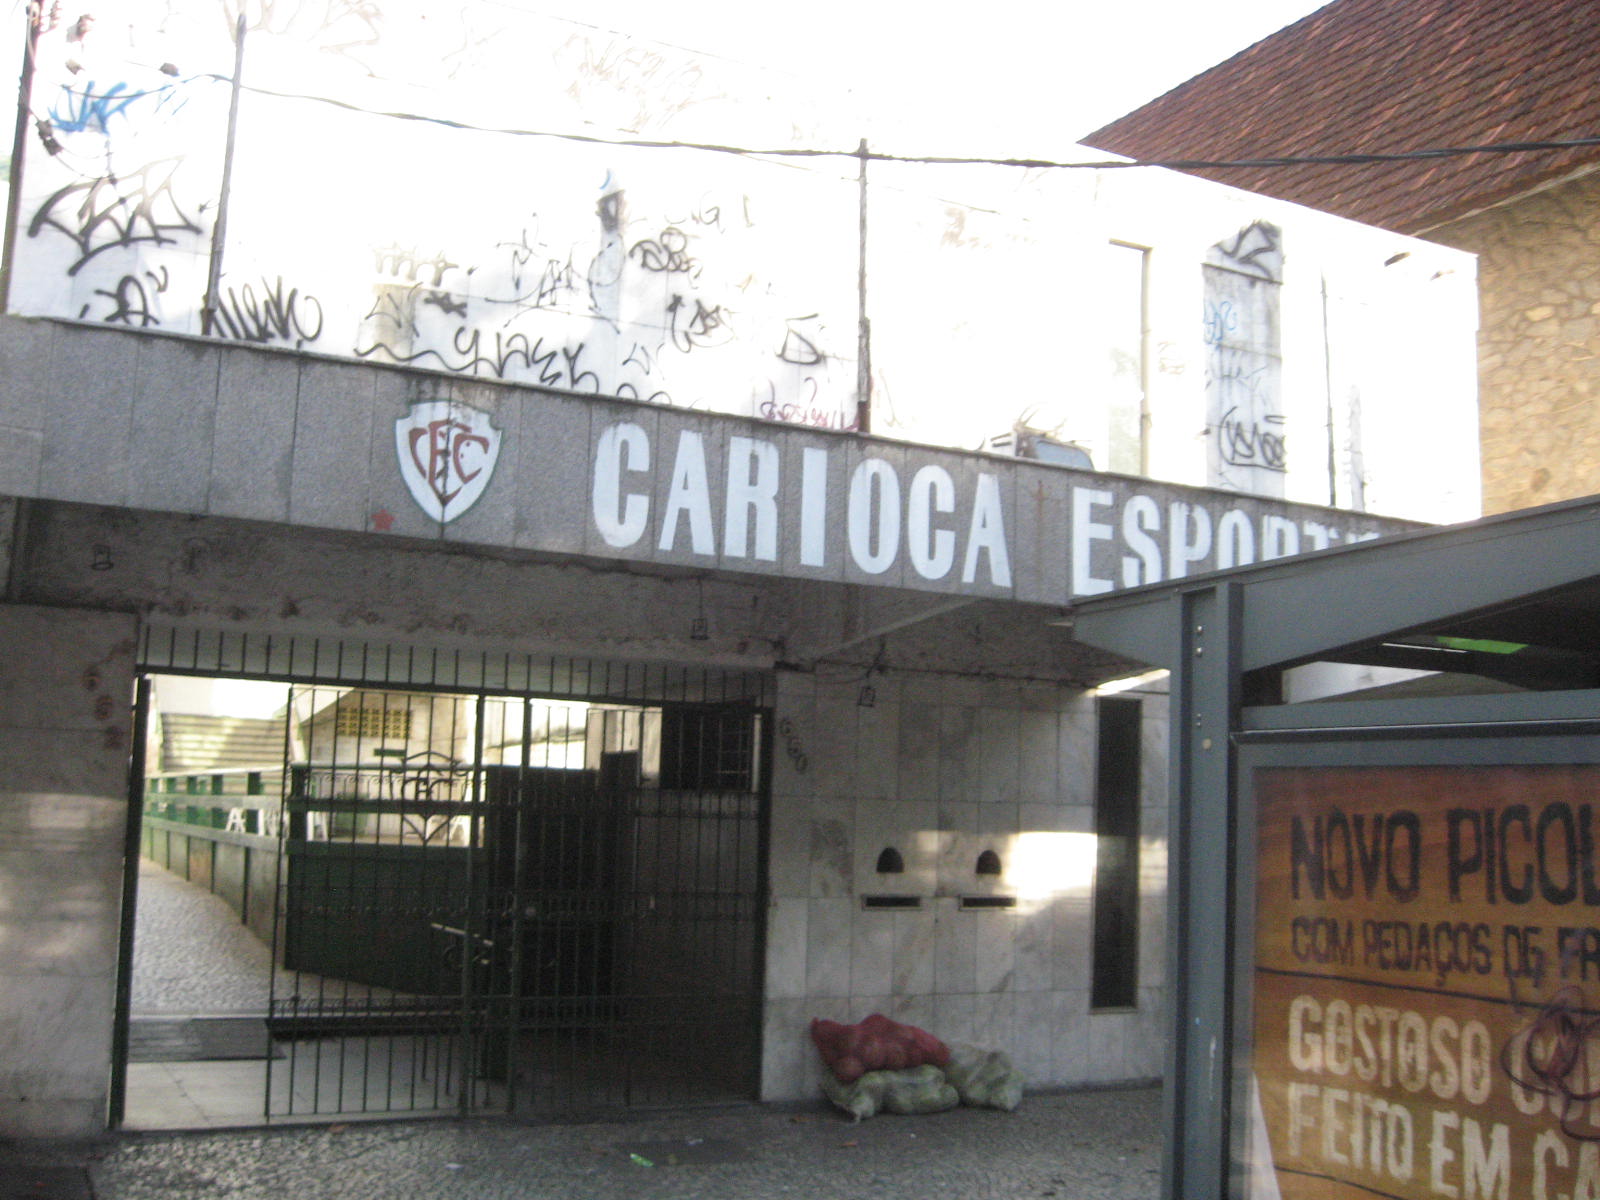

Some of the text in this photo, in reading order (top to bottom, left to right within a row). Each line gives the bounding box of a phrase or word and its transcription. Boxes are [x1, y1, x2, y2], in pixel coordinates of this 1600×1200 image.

[592, 421, 1013, 588] CARIOCA
[1289, 801, 1600, 907] NOVO PICOL
[1291, 915, 1355, 966] COM
[1362, 919, 1493, 987] PEDAÇOS
[1287, 994, 1492, 1105] GOSTOSO
[1287, 1081, 1414, 1181] FEITO
[1428, 1109, 1512, 1200] EM
